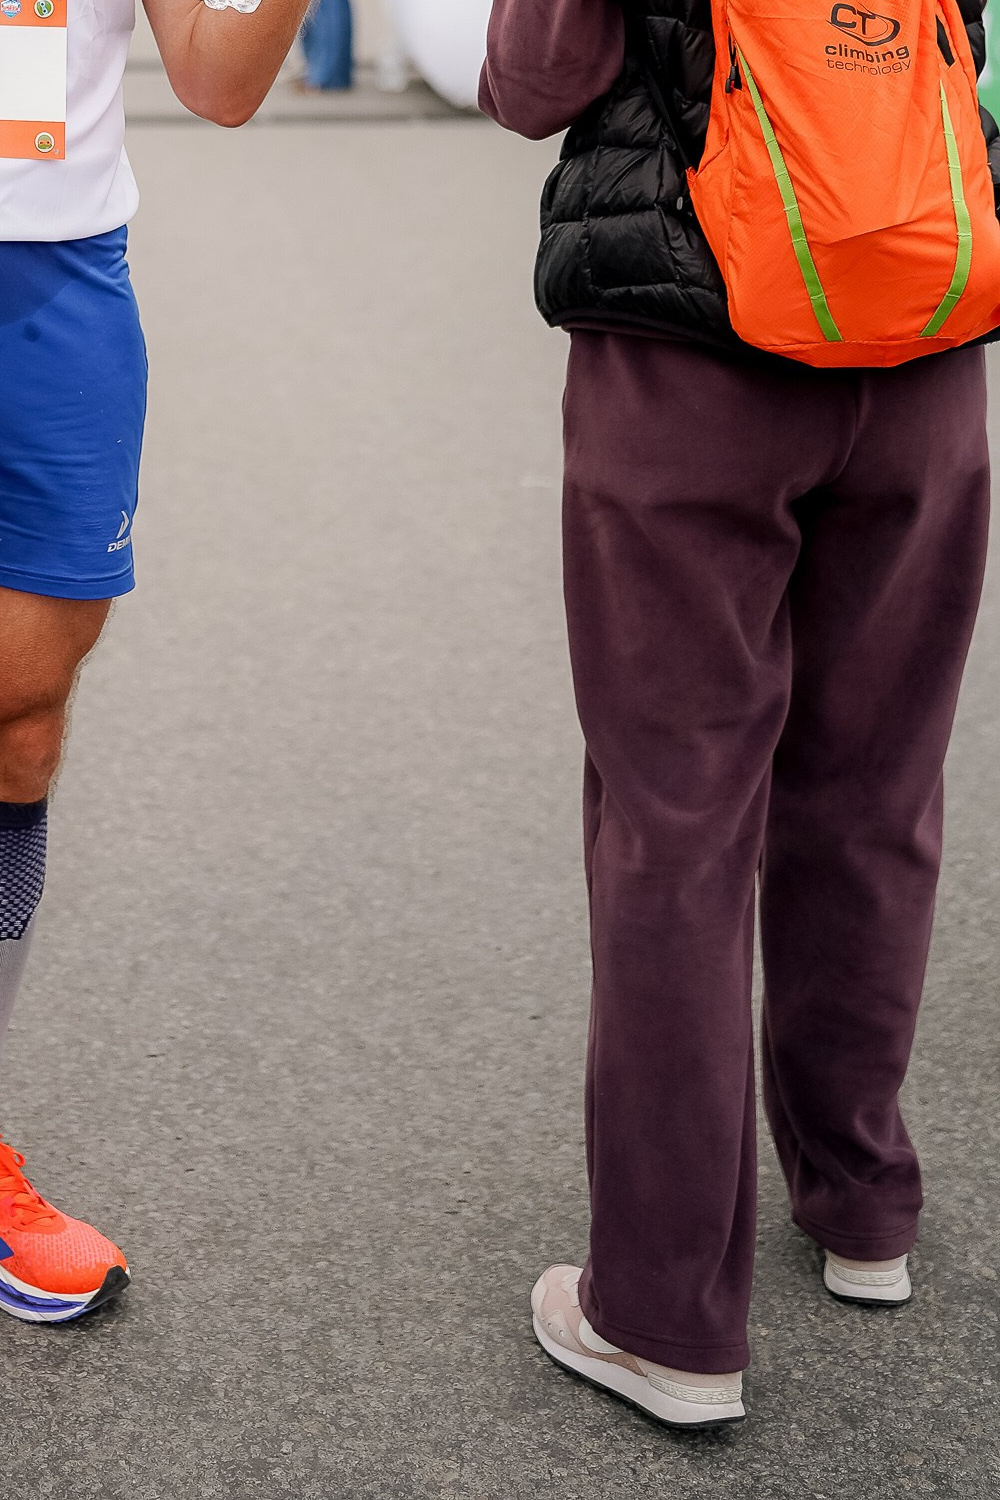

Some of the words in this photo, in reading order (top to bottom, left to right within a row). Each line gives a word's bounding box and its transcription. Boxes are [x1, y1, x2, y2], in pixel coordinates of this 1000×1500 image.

[831, 3, 877, 35] CT
[825, 43, 910, 63] climbing
[826, 58, 912, 76] technology
